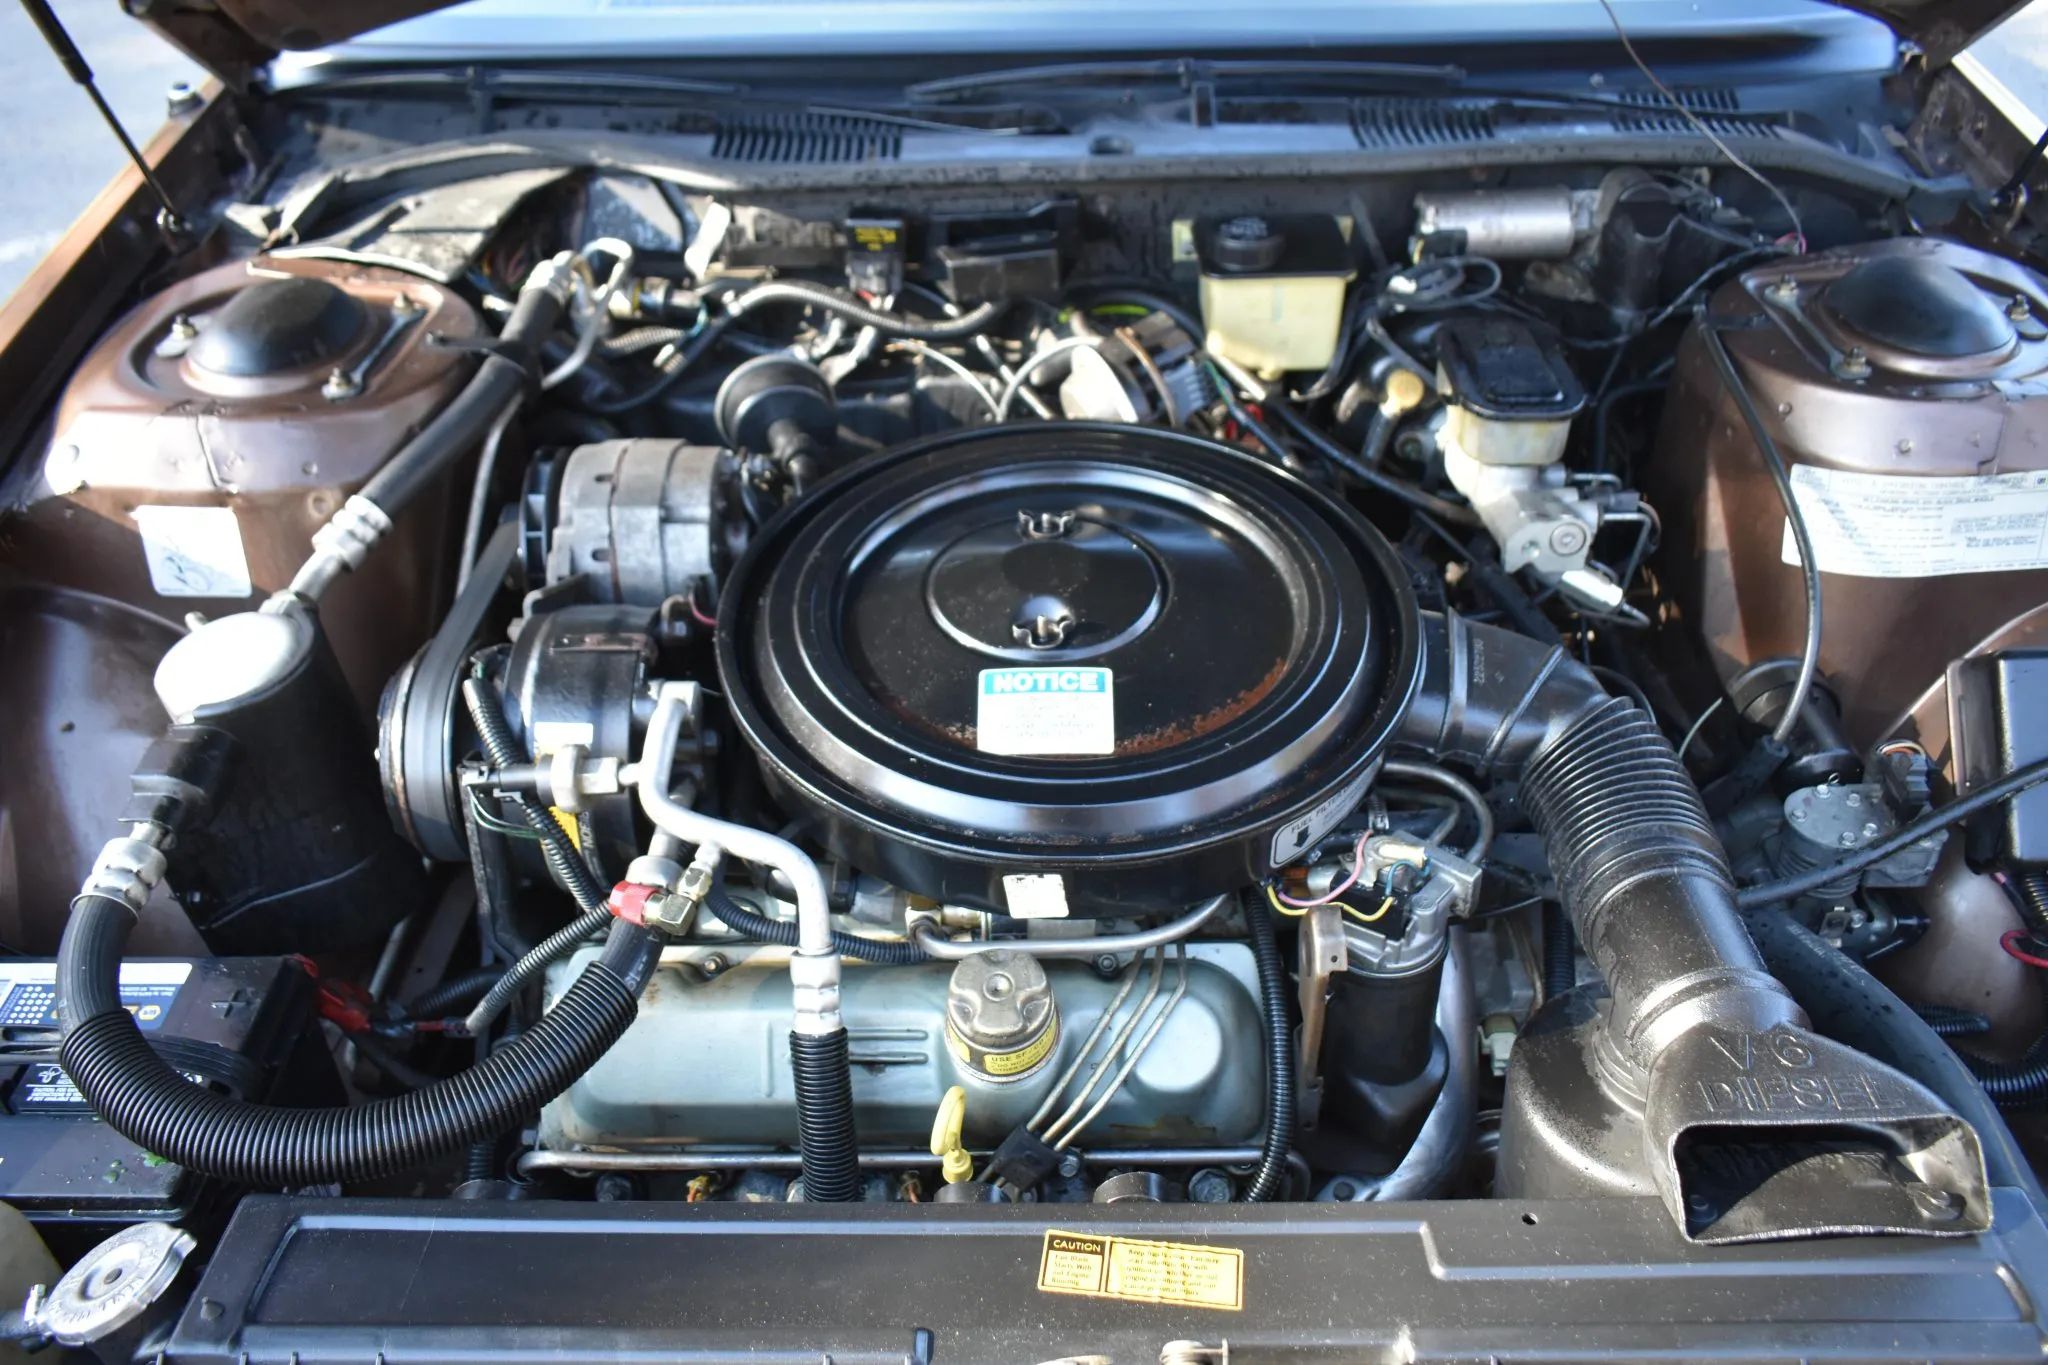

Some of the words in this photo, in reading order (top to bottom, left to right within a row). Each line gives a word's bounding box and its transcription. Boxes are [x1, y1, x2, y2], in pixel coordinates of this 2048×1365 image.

[993, 671, 1099, 692] NOTICE
[1291, 816, 1312, 833] FUEL
[1697, 1073, 1907, 1113] DIESEL
[1053, 1239, 1101, 1252] CAUTION
